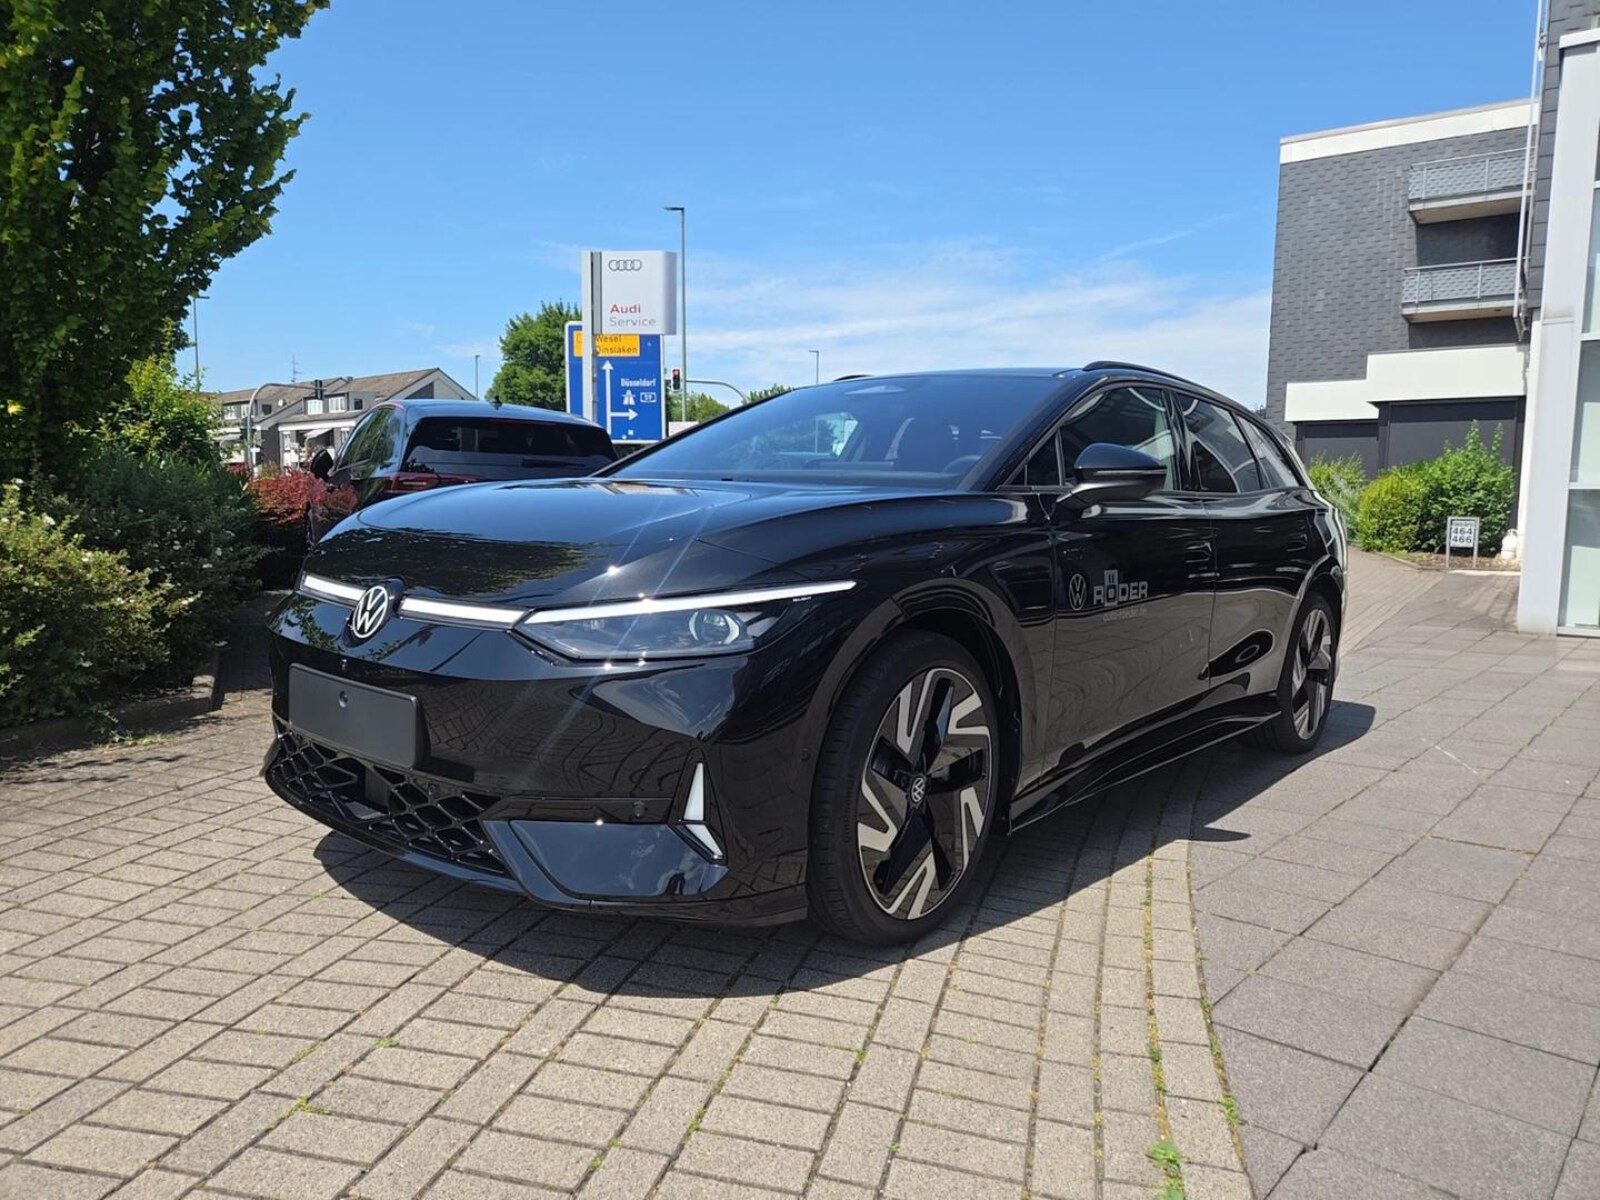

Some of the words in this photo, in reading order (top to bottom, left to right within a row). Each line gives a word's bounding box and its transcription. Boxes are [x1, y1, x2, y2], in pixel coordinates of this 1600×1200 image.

[610, 304, 641, 314] Audi
[609, 316, 656, 327] Service
[621, 378, 656, 387] Düsseldorf
[1452, 527, 1472, 535] 464
[1451, 536, 1472, 544] 466
